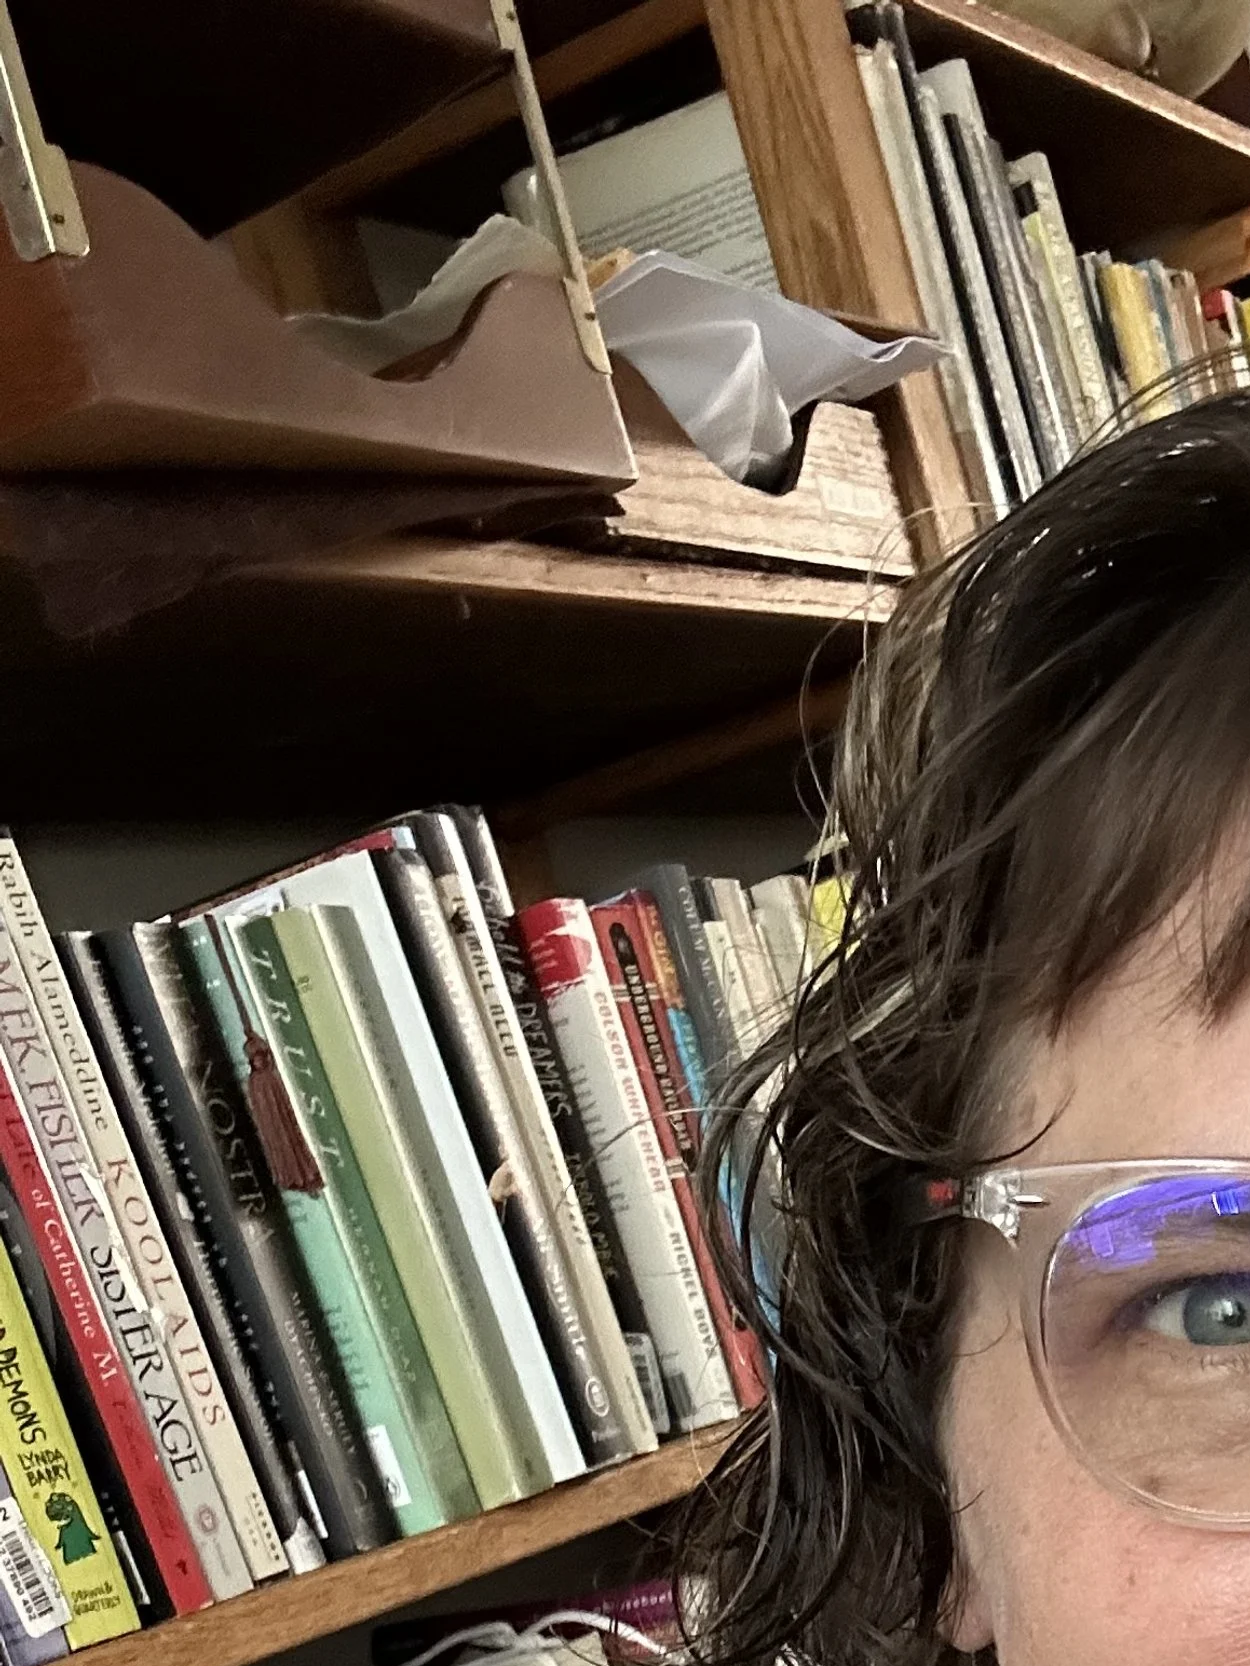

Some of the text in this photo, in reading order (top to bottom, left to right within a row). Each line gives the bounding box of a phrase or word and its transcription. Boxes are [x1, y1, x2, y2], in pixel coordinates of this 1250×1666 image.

[0, 847, 43, 941] Rabih
[27, 942, 114, 1135] Alameddine
[591, 988, 631, 1073] COLSON
[248, 946, 347, 1173] TRUST
[514, 996, 575, 1125] DREAMERS
[40, 1214, 101, 1340] Catherine
[88, 1343, 122, 1389] M.
[103, 1152, 228, 1429] KOOLAIDS
[0, 1343, 50, 1448] DEMONS
[141, 1380, 206, 1484] AGE
[18, 1448, 66, 1471] LYNDA
[27, 1462, 71, 1488] BARRY
